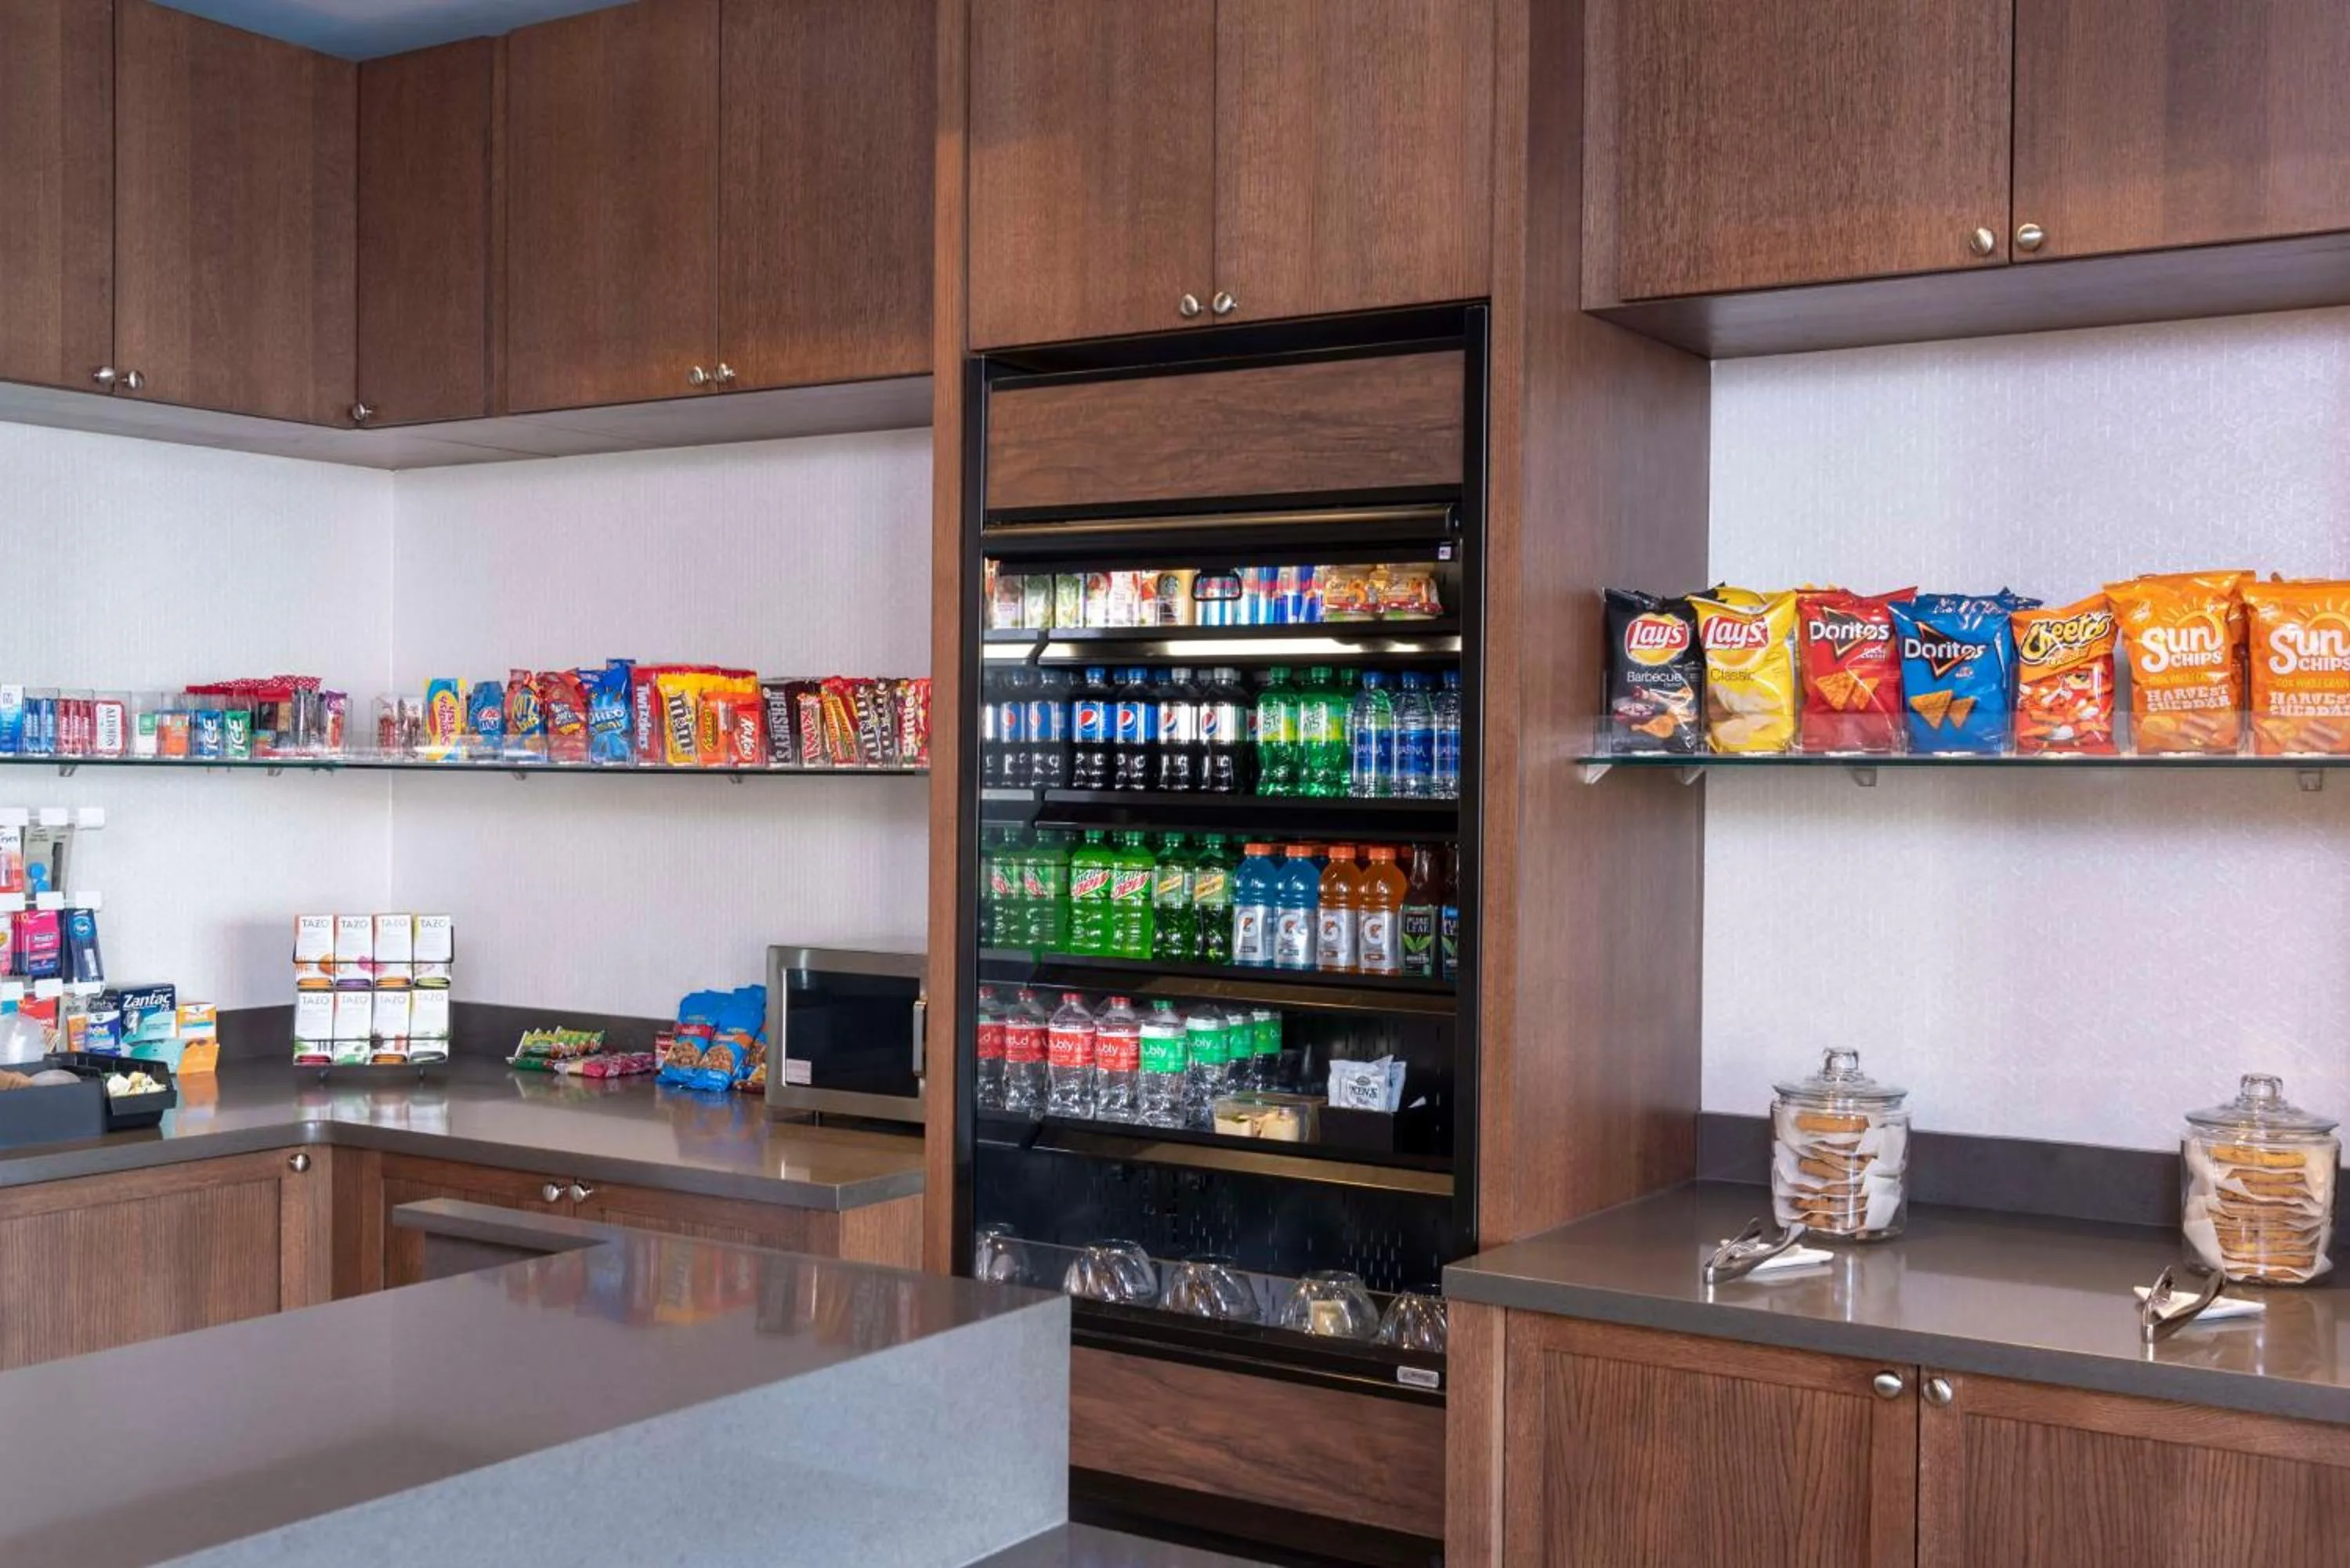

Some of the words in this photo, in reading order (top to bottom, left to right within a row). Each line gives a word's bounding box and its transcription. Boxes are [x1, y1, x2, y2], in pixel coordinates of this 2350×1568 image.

[1808, 621, 1890, 641] Doritos
[1904, 638, 1987, 659] Doritos
[2141, 624, 2225, 674] Sun
[2269, 623, 2350, 674] Sun
[2170, 652, 2224, 667] CHIPS
[1626, 671, 1683, 682] Barbecue
[2146, 685, 2229, 701] HARVEST
[769, 691, 791, 759] HERSHEY'S
[302, 918, 330, 928] TAZO
[342, 919, 368, 929] TAZO
[420, 919, 447, 929] TAZO
[123, 993, 172, 1009] Zantac
[302, 995, 330, 1005] TAZO
